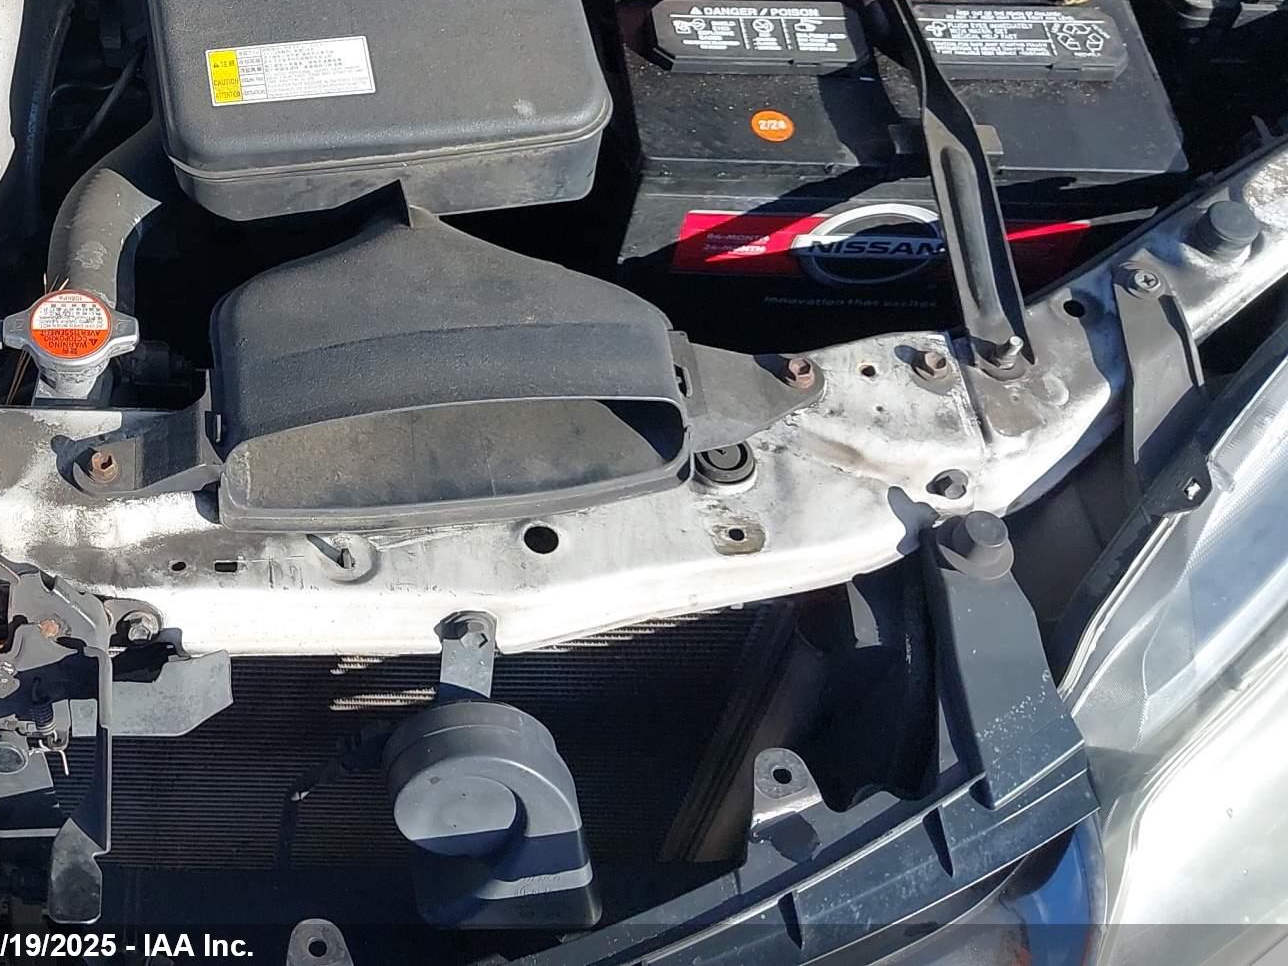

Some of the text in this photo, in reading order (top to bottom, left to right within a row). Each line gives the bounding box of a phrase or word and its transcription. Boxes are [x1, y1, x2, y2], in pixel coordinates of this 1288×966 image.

[704, 7, 757, 16] DANGER
[770, 8, 820, 17] POISON
[213, 77, 239, 87] CAUTION
[808, 240, 947, 256] NISSAN
